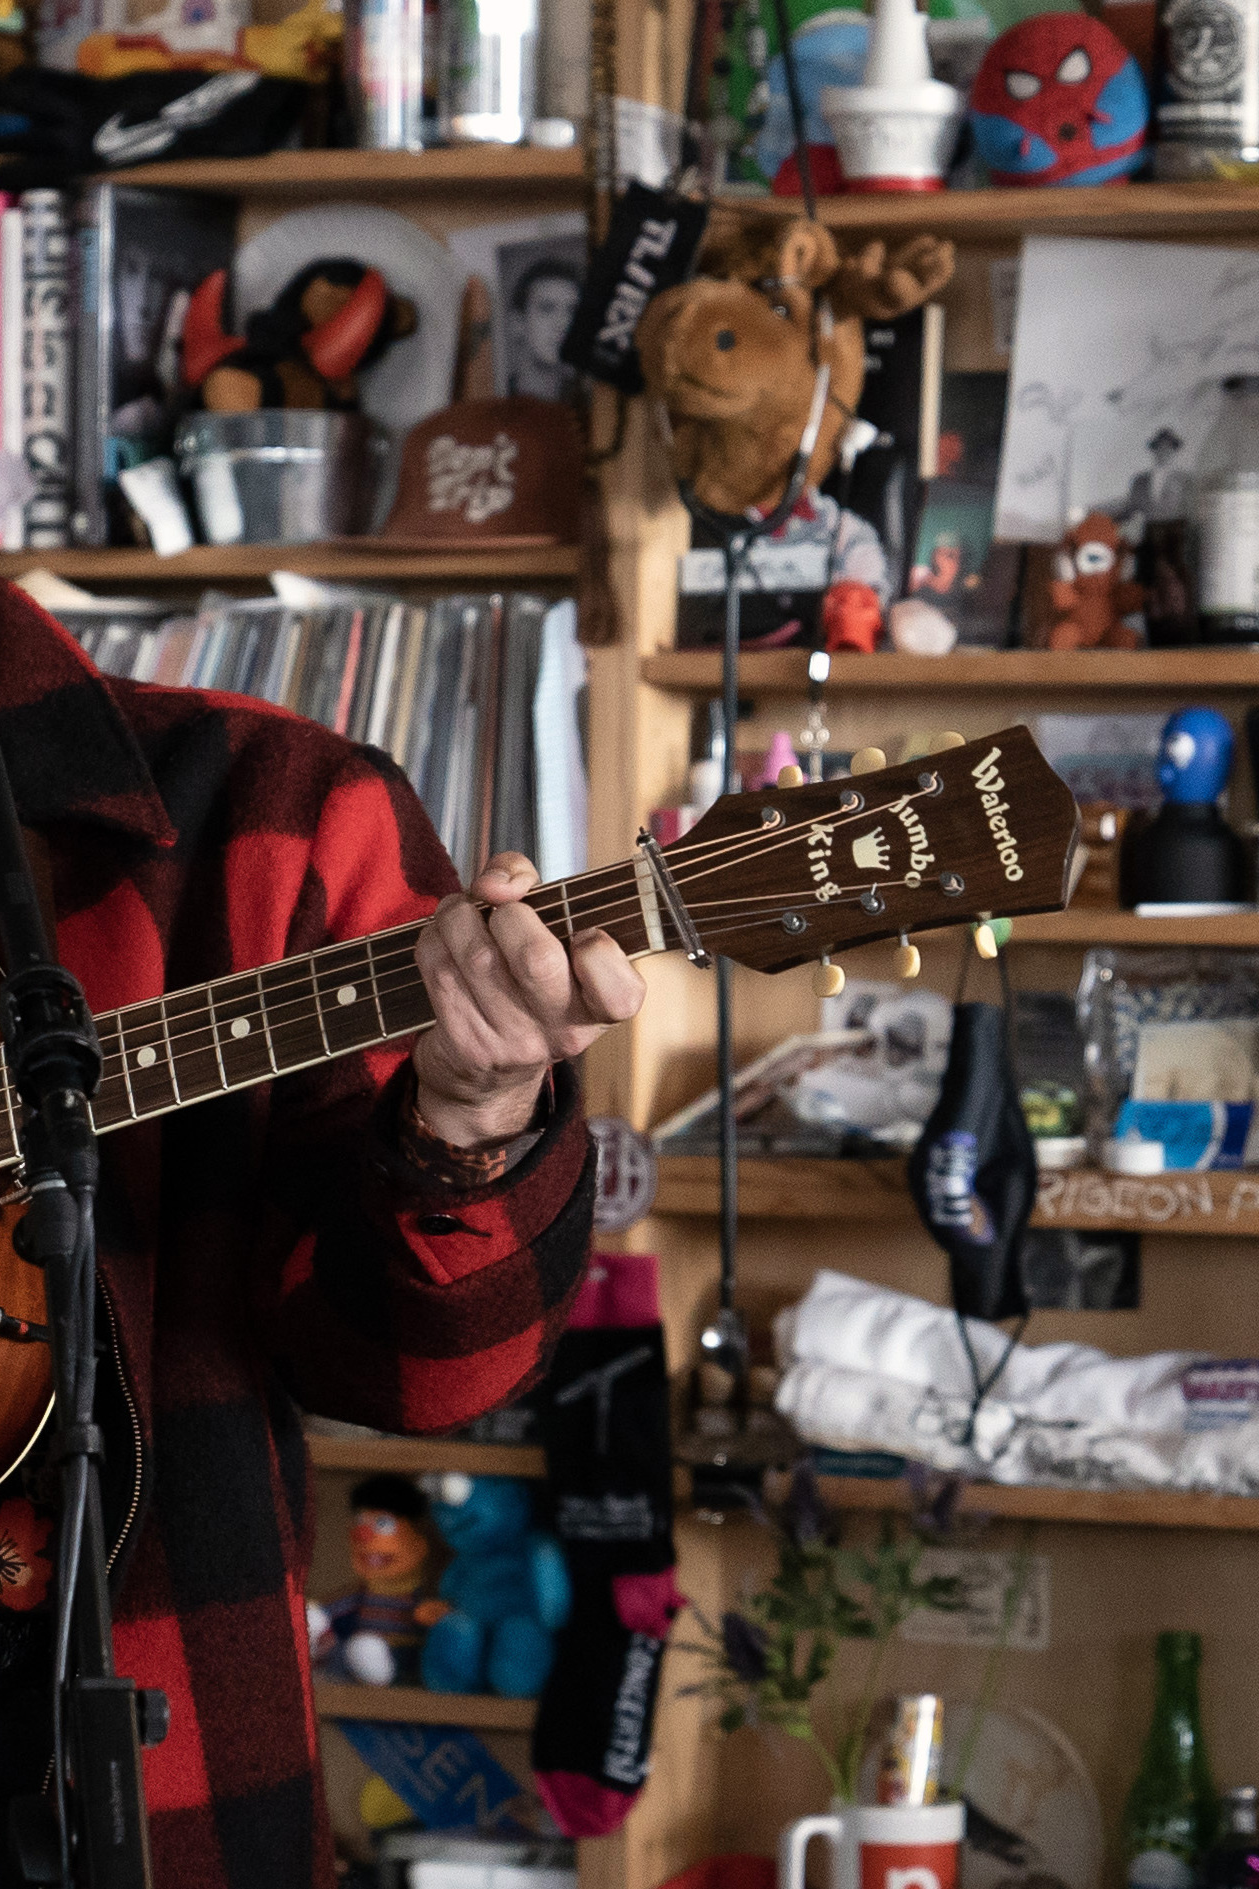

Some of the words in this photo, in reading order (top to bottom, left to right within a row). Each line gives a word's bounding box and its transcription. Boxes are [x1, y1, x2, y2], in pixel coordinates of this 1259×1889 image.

[888, 794, 935, 889] Jumbo
[971, 746, 1024, 882] Waterloo
[807, 823, 842, 902] King
